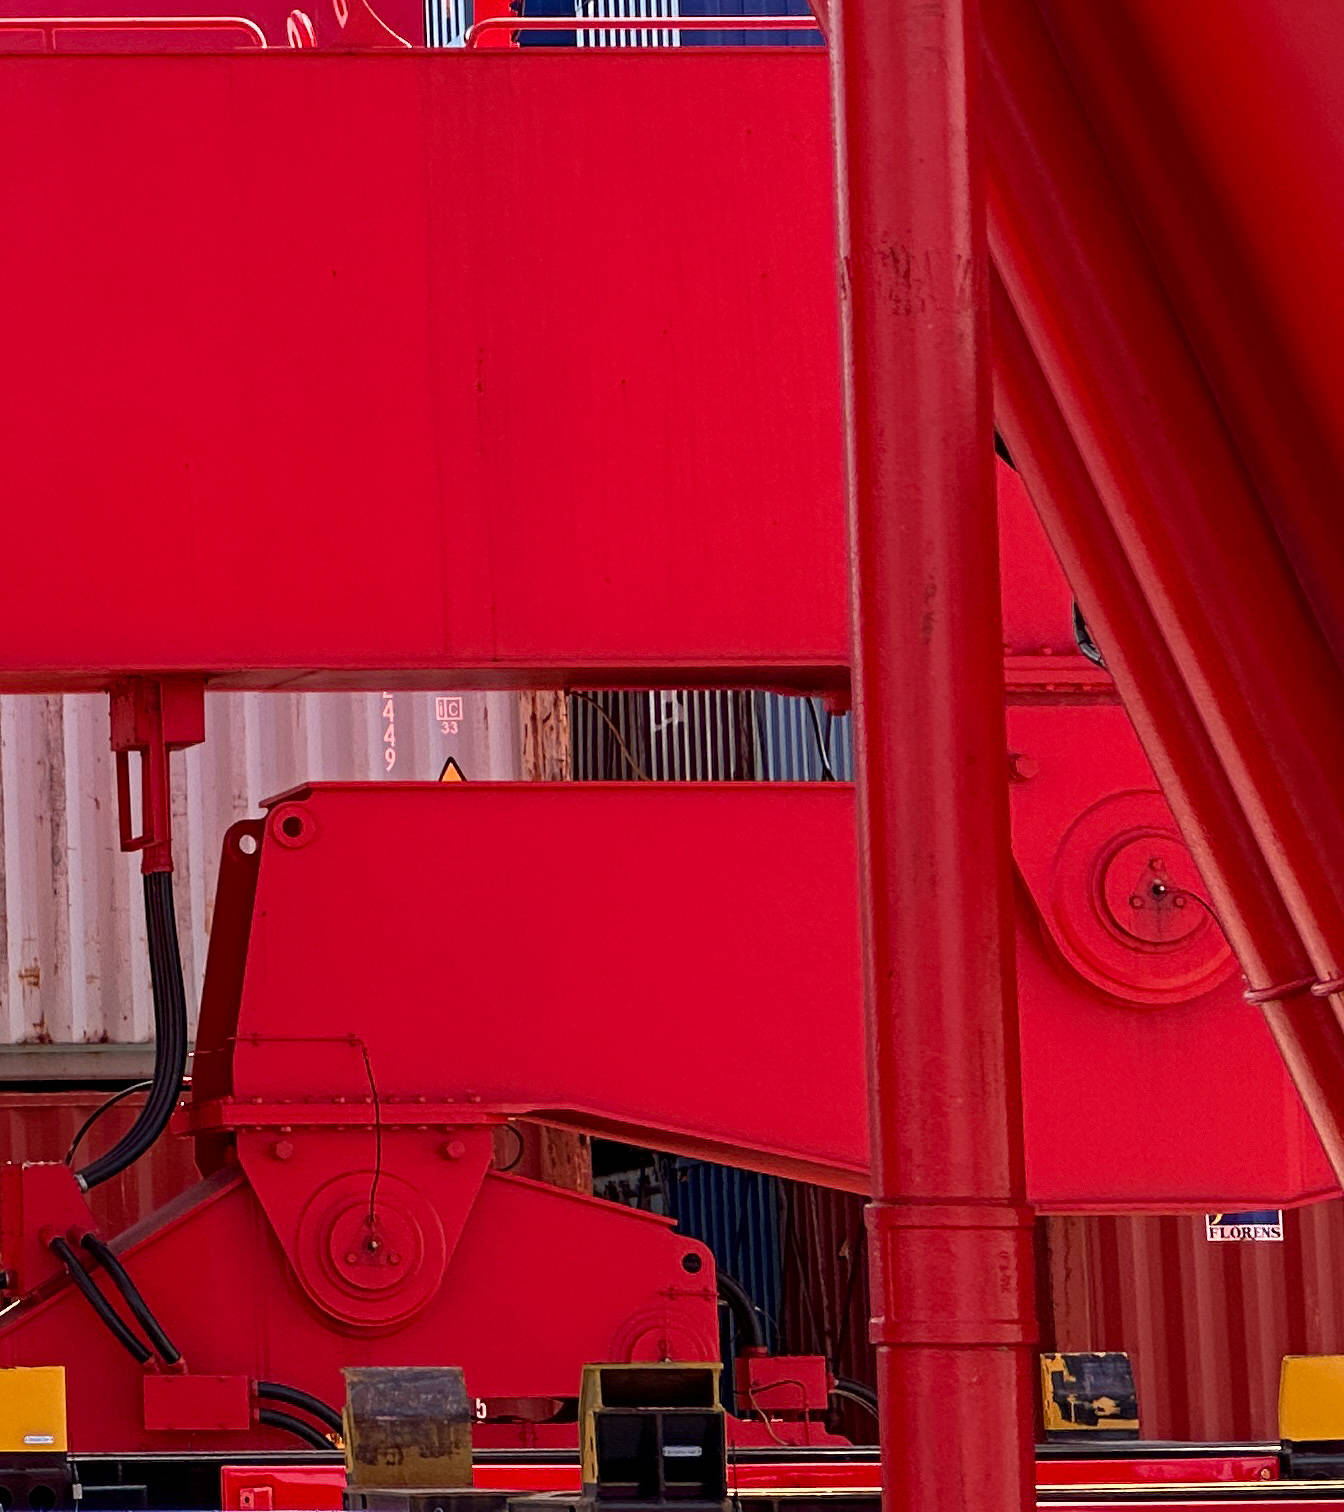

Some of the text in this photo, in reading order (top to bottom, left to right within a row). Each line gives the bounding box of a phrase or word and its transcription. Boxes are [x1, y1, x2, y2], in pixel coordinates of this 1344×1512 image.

[382, 691, 396, 772] 449
[441, 721, 458, 734] 33
[1209, 1225, 1282, 1239] FLORENS
